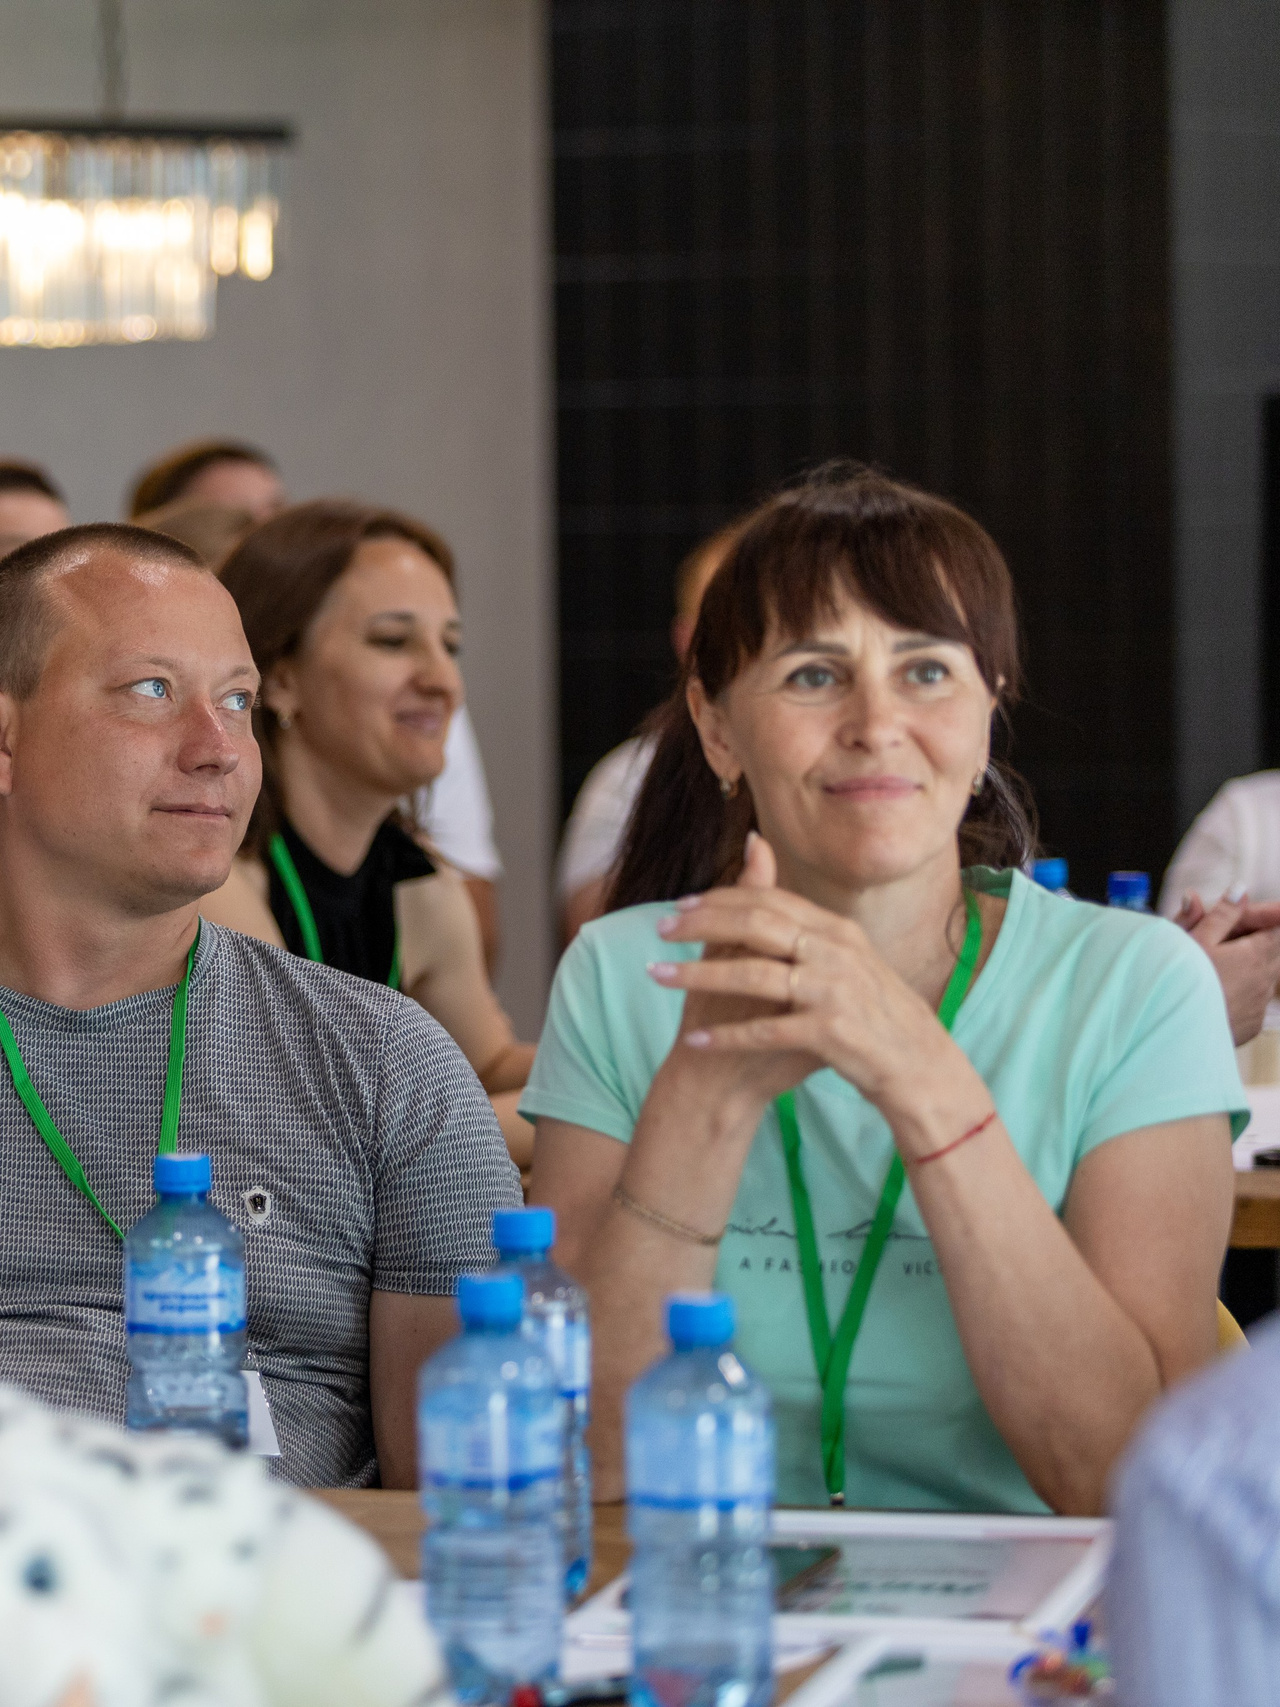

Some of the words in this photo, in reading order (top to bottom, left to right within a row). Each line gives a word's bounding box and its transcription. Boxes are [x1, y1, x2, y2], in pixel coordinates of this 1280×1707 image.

[738, 1256, 752, 1271] A
[763, 1257, 859, 1275] FAIO
[902, 1259, 937, 1276] VIC
